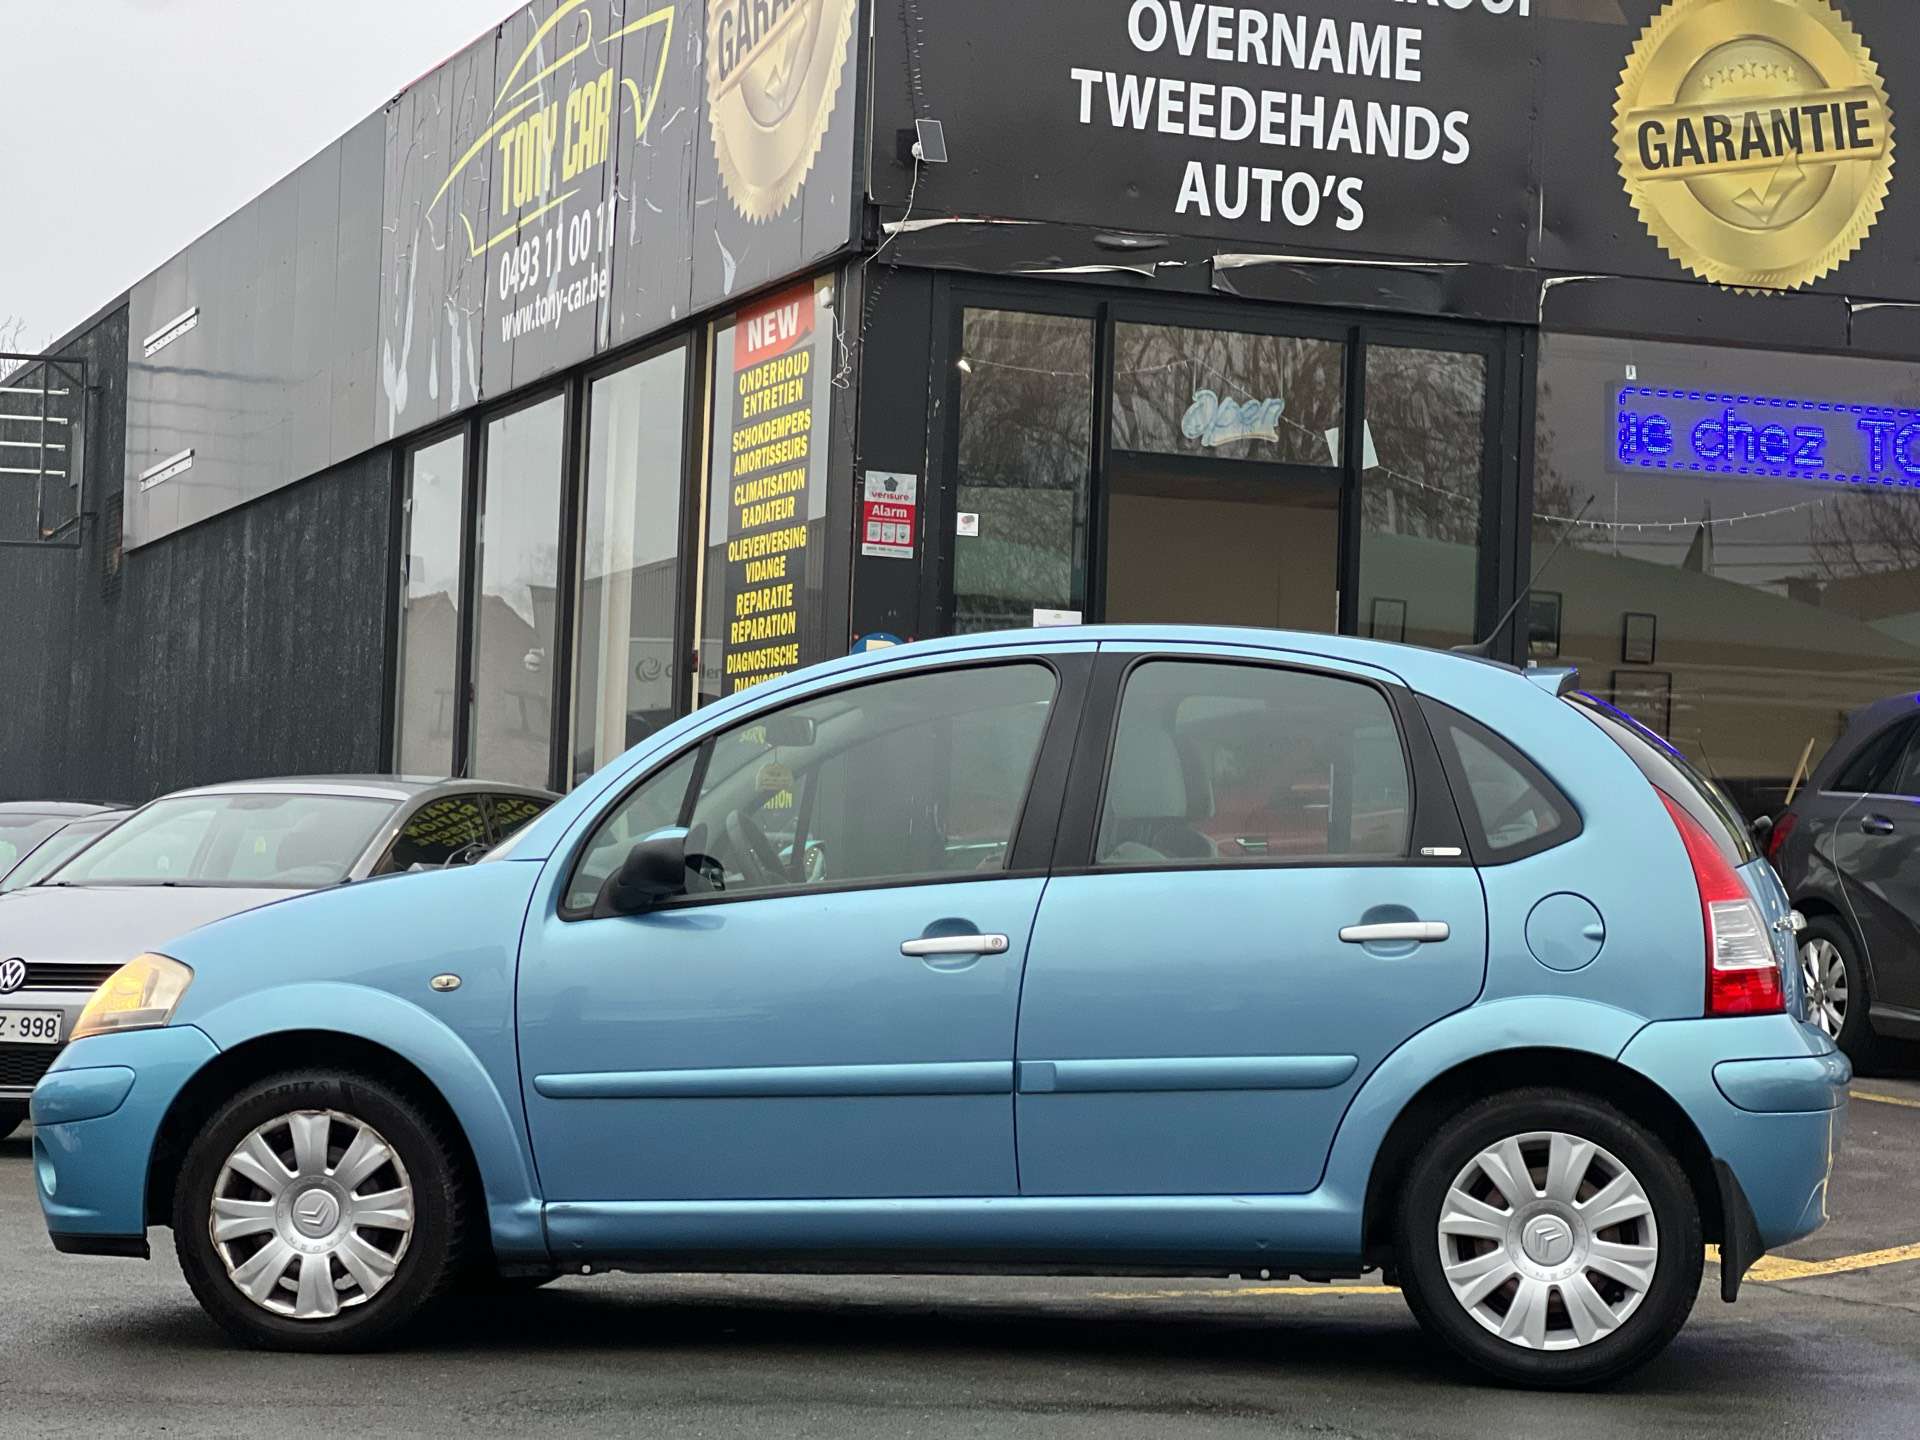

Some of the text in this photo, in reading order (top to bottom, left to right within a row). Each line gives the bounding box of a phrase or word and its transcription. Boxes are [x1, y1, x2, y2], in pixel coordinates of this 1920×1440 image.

[1127, 0, 1422, 82] OVERNAME
[1070, 67, 1470, 165] TWEEDEHANDS
[1637, 100, 1874, 171] GARANTIE
[499, 68, 613, 216] TONY CAR
[1174, 160, 1364, 231] AUTO'S
[500, 235, 540, 300] 0493
[545, 223, 564, 278] 11
[568, 208, 591, 266] 00
[501, 262, 608, 342] www.tony-car.be
[747, 302, 799, 352] NEW
[740, 351, 809, 395] ONDERHOUD
[743, 378, 803, 419] ENTRETIEN
[732, 408, 811, 453] SCHOKDEMPERS
[1694, 407, 1825, 467] chez
[734, 434, 808, 477] AMORTISSEURS
[734, 467, 805, 506] CLIMATISATION
[742, 495, 795, 528] RADIATEUR
[872, 504, 907, 518] Alarm
[728, 525, 807, 562] OLIEVERVERSING
[745, 555, 786, 583] VIDANGE
[736, 583, 793, 616] REPARATIE
[731, 611, 796, 644] RÉPARATION
[727, 643, 799, 675] DIAGNOSTISCHE
